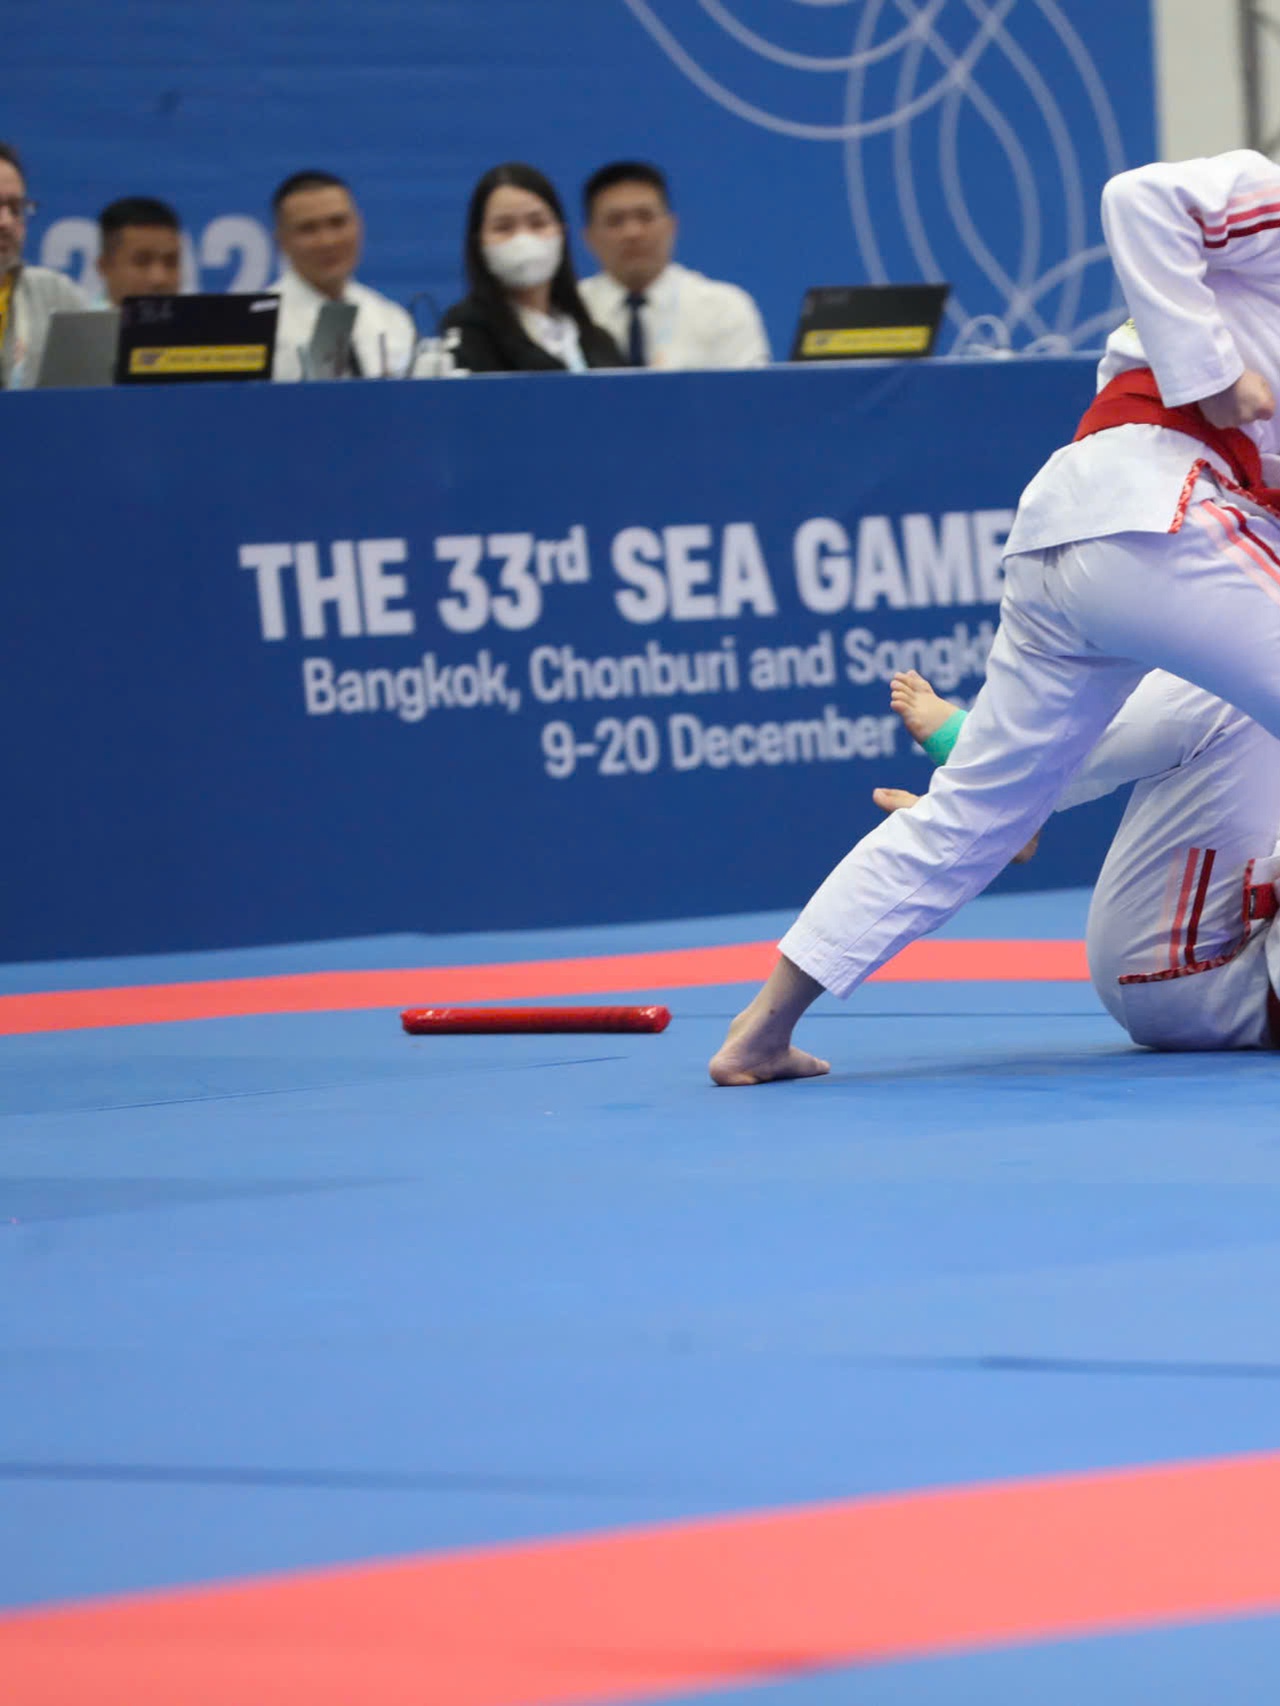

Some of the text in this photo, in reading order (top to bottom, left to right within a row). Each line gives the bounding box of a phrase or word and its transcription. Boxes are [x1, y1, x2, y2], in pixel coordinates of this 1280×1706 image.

[239, 509, 1014, 641] THE 33rd SEA GAME
[303, 648, 521, 722] Bangkok,
[529, 636, 740, 703] Chonburi
[750, 630, 836, 691] and
[669, 706, 898, 771] December
